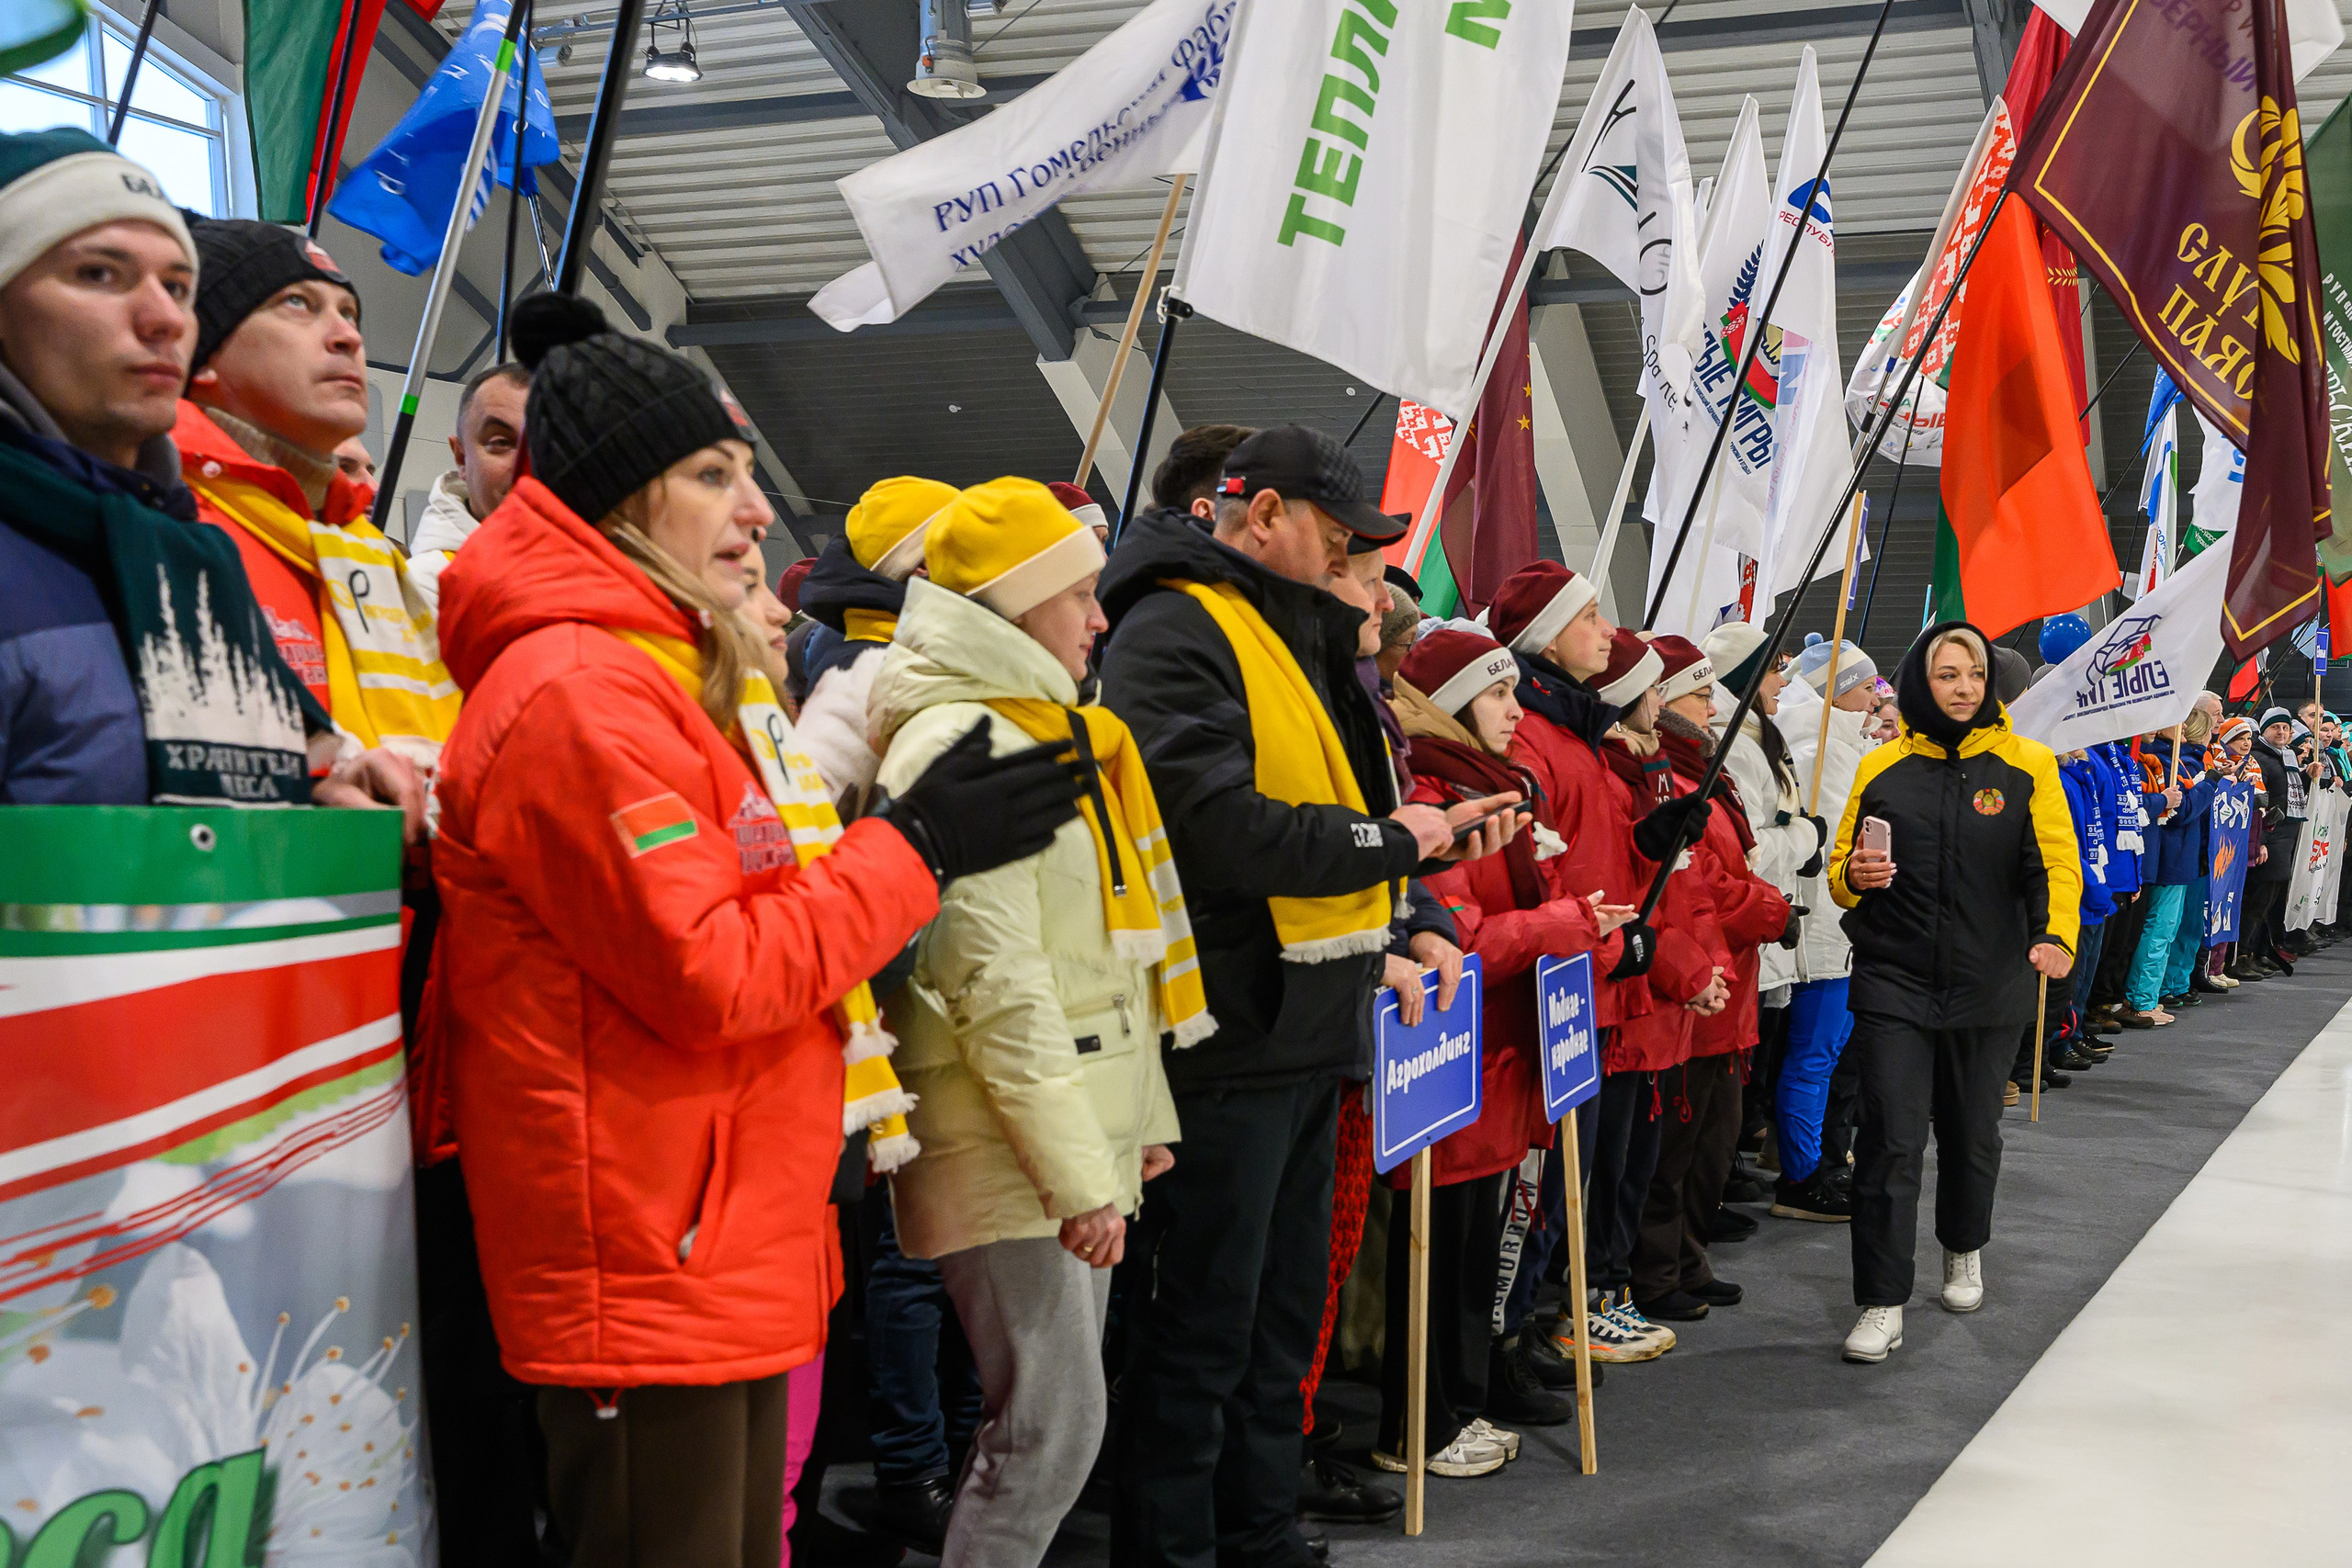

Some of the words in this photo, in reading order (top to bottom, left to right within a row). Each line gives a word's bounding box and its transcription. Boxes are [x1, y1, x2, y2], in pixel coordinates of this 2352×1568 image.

[933, 181, 1004, 232] РУП
[1171, 1, 1238, 71] Фаб
[1779, 210, 1835, 256] РЕСПУБЛ
[2322, 273, 2347, 304] РУП
[1694, 321, 1736, 394] ЛЫЕ
[1386, 1031, 1471, 1096] Агрохолдинг
